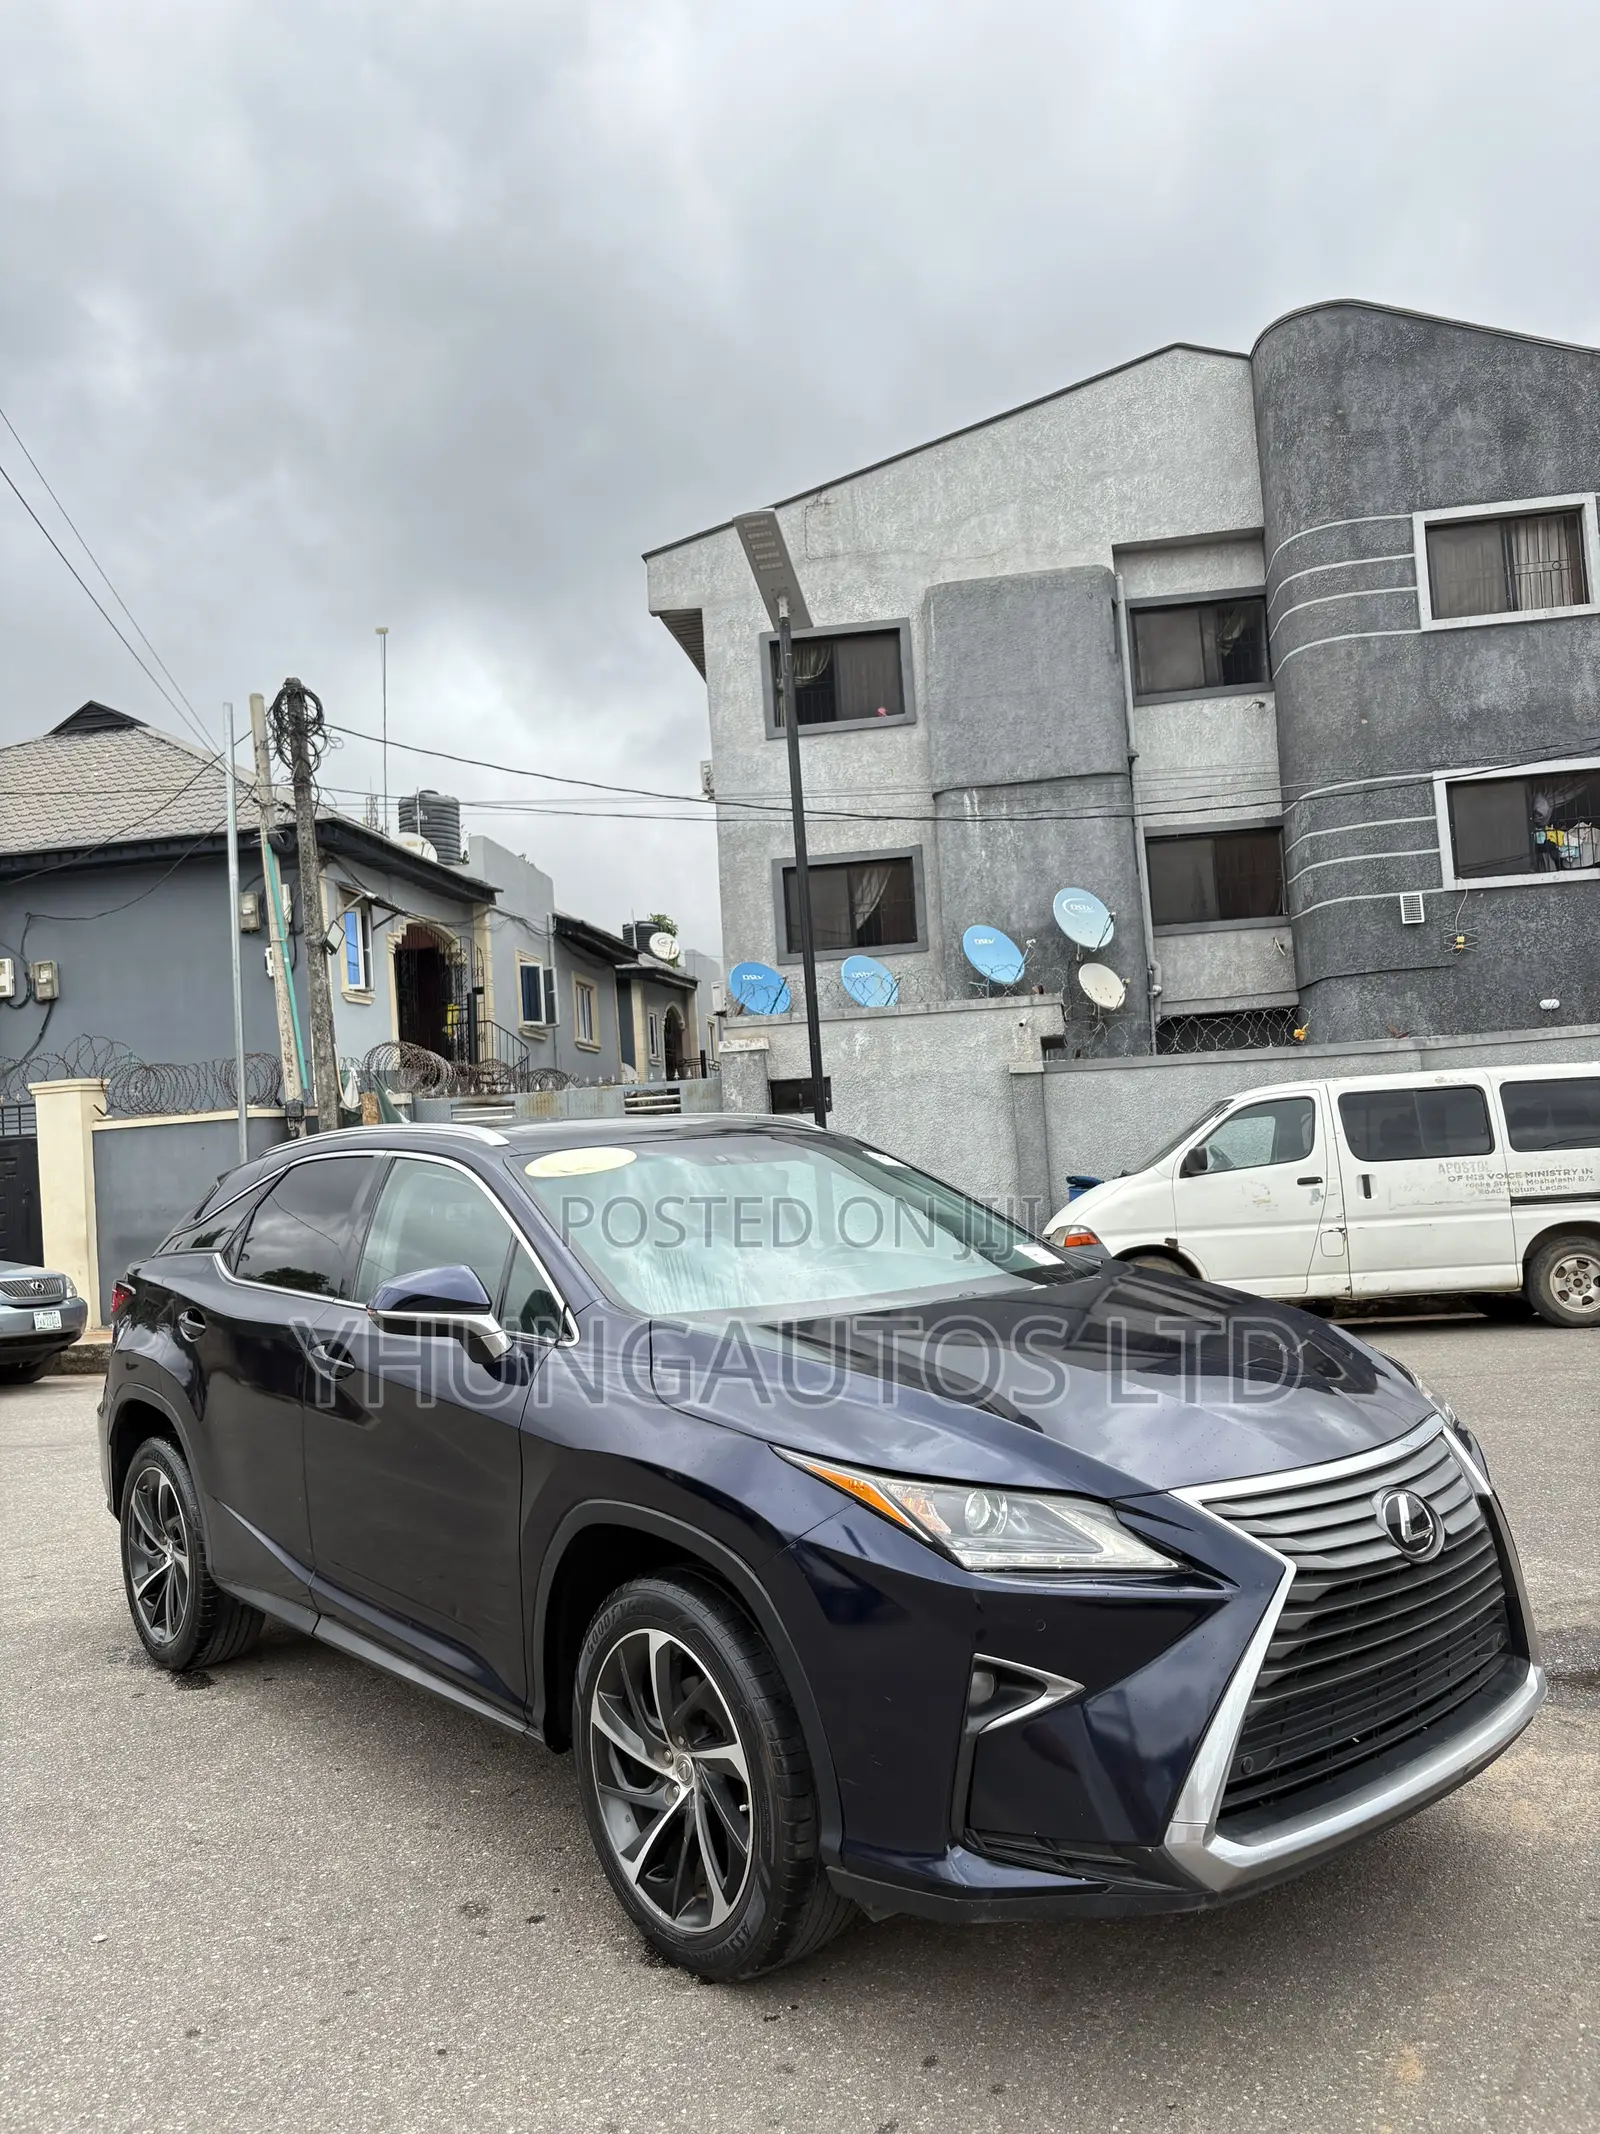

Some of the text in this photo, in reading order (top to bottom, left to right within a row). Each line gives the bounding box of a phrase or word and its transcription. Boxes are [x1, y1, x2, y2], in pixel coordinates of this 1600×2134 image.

[1448, 1174, 1463, 1182] OF
[1466, 1173, 1485, 1181] HIS
[1487, 1171, 1522, 1180] VOICE
[1525, 1168, 1578, 1178] MINISTRY
